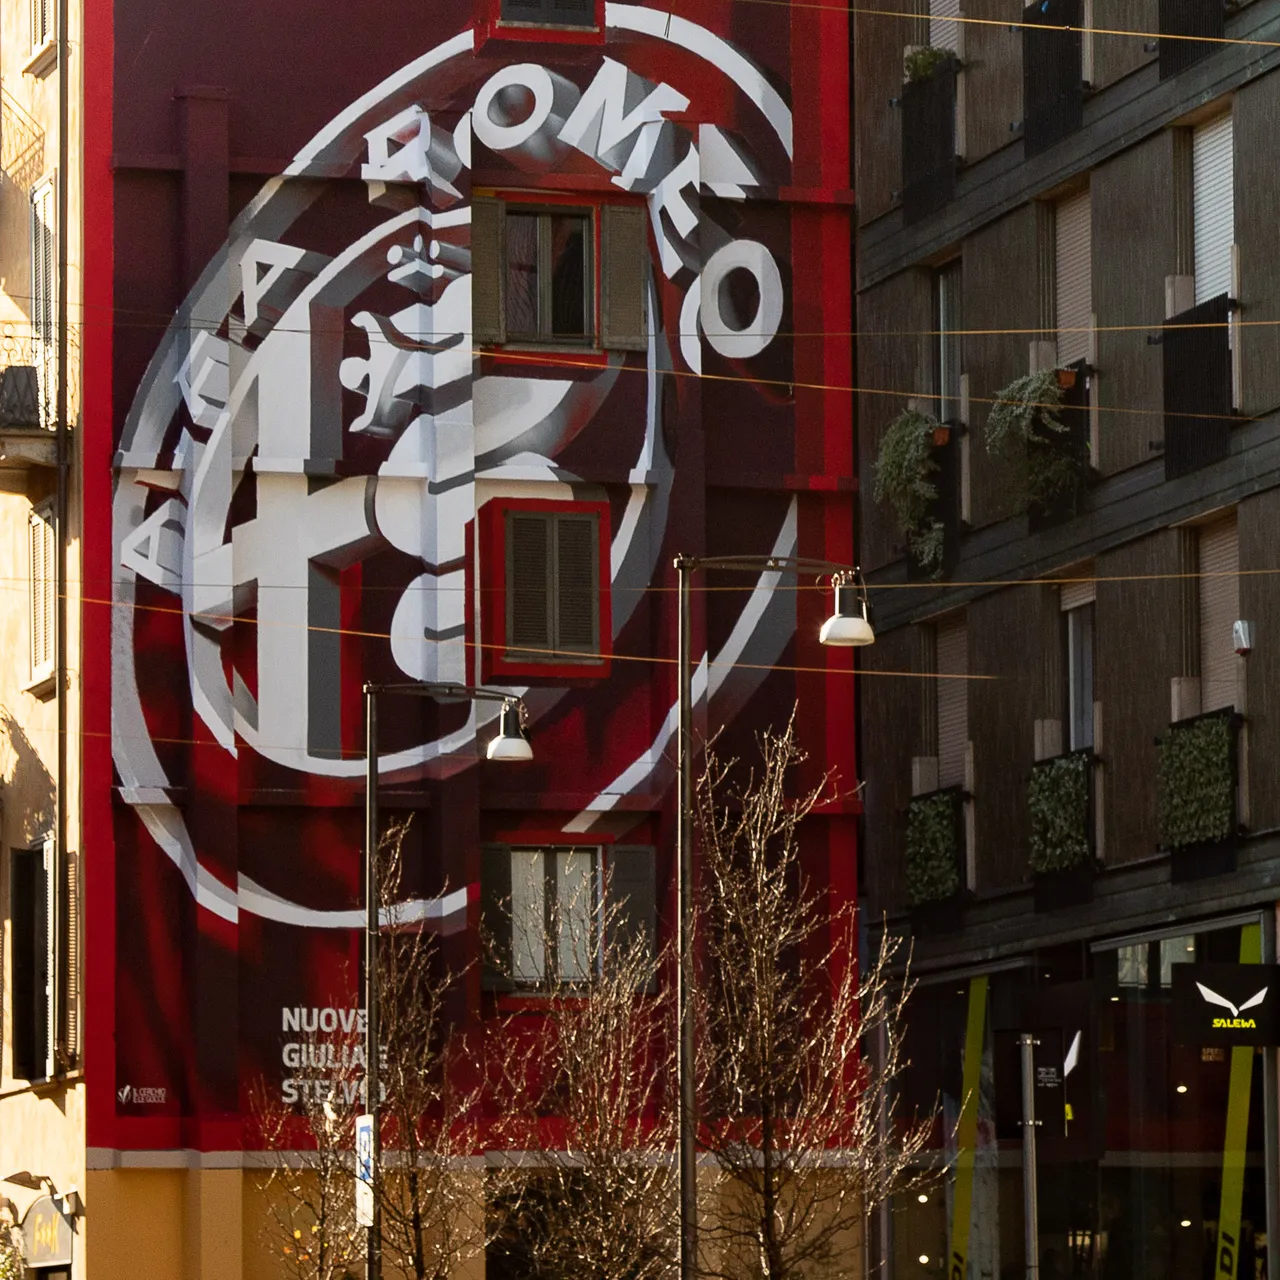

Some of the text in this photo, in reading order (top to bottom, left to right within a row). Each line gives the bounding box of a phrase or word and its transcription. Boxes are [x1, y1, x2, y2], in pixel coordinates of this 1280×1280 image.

[360, 56, 784, 377] ROMEO
[282, 1007, 367, 1033] NUOVE
[1212, 1017, 1256, 1028] SALEWA
